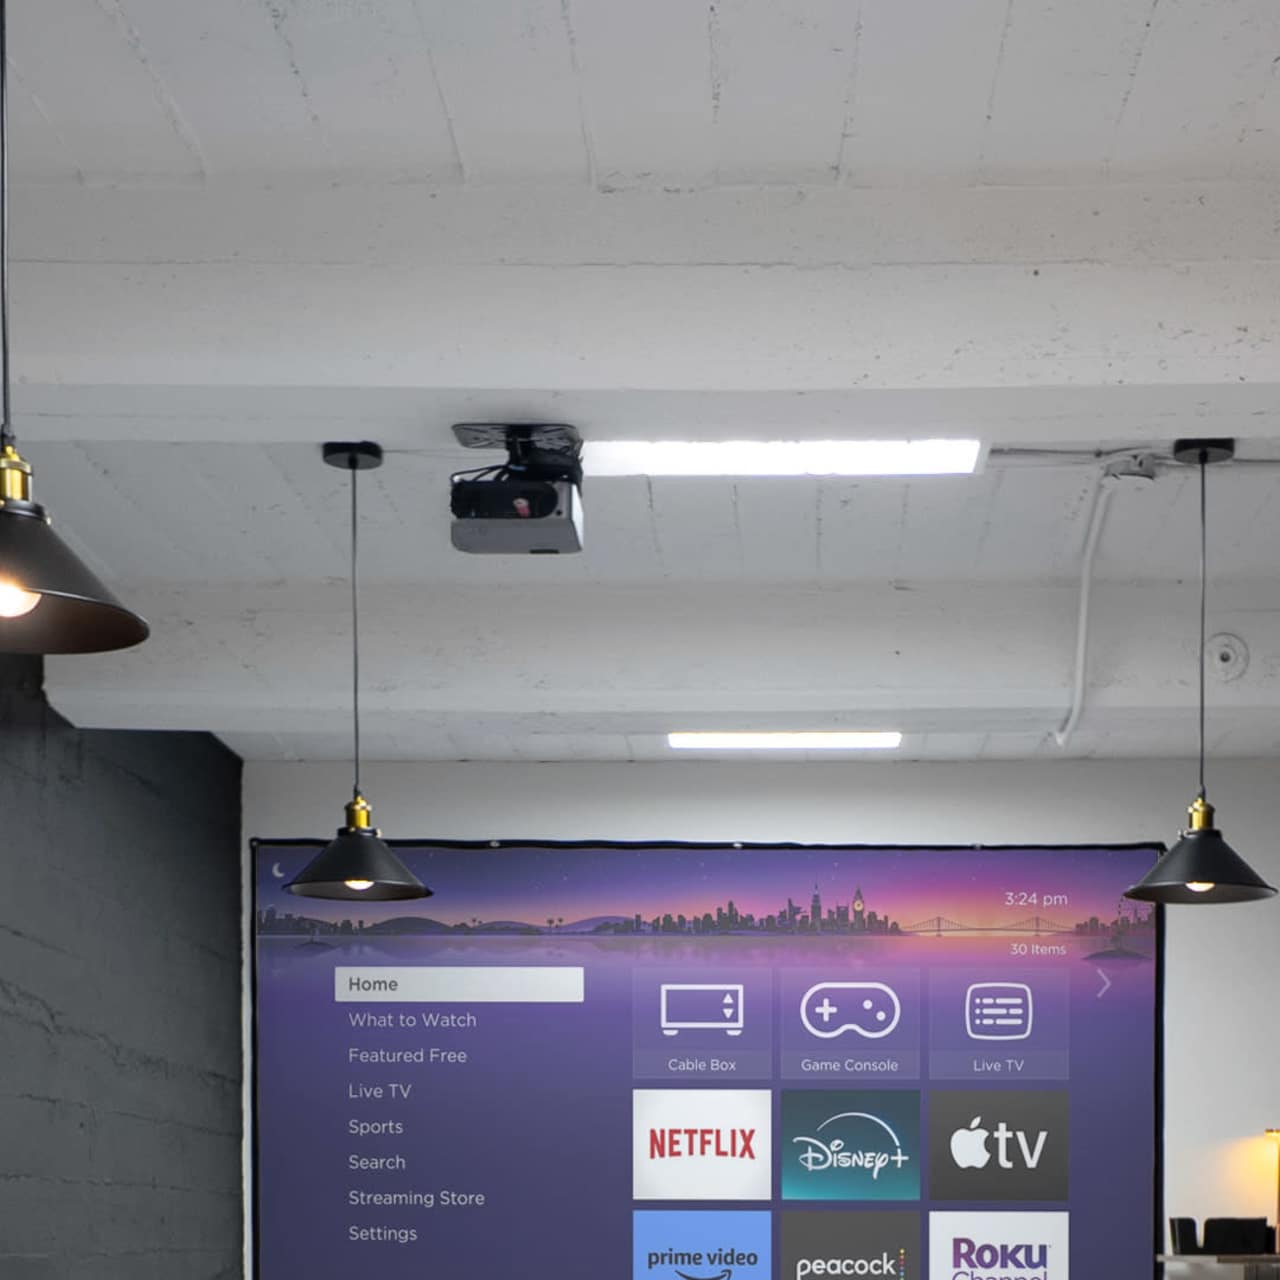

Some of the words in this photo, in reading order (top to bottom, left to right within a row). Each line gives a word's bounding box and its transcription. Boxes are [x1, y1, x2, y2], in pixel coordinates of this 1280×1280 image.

[1004, 891, 1038, 907] 3:24
[1043, 893, 1068, 909] pm
[1010, 943, 1028, 956] 30
[1031, 944, 1067, 956] Items
[349, 977, 398, 991] Home
[349, 1013, 393, 1027] What
[400, 1014, 416, 1027] to
[422, 1013, 476, 1027] Watch
[349, 1048, 423, 1062] Featured
[430, 1048, 467, 1062] Free
[668, 1059, 706, 1071] Cable
[711, 1059, 736, 1071] Box
[801, 1059, 841, 1072] Game
[844, 1058, 899, 1072] Console
[973, 1060, 1001, 1072] Live
[1005, 1060, 1025, 1072] TV
[349, 1084, 383, 1098] Live
[389, 1084, 411, 1098] TV
[349, 1120, 403, 1136] Sports
[650, 1129, 755, 1159] NETFLIX
[349, 1155, 405, 1169] Search
[349, 1191, 434, 1208] Streaming
[440, 1191, 484, 1205] Store
[349, 1226, 417, 1243] Settings
[648, 1248, 703, 1269] prime
[707, 1248, 758, 1265] video
[952, 1237, 1047, 1270] Roku
